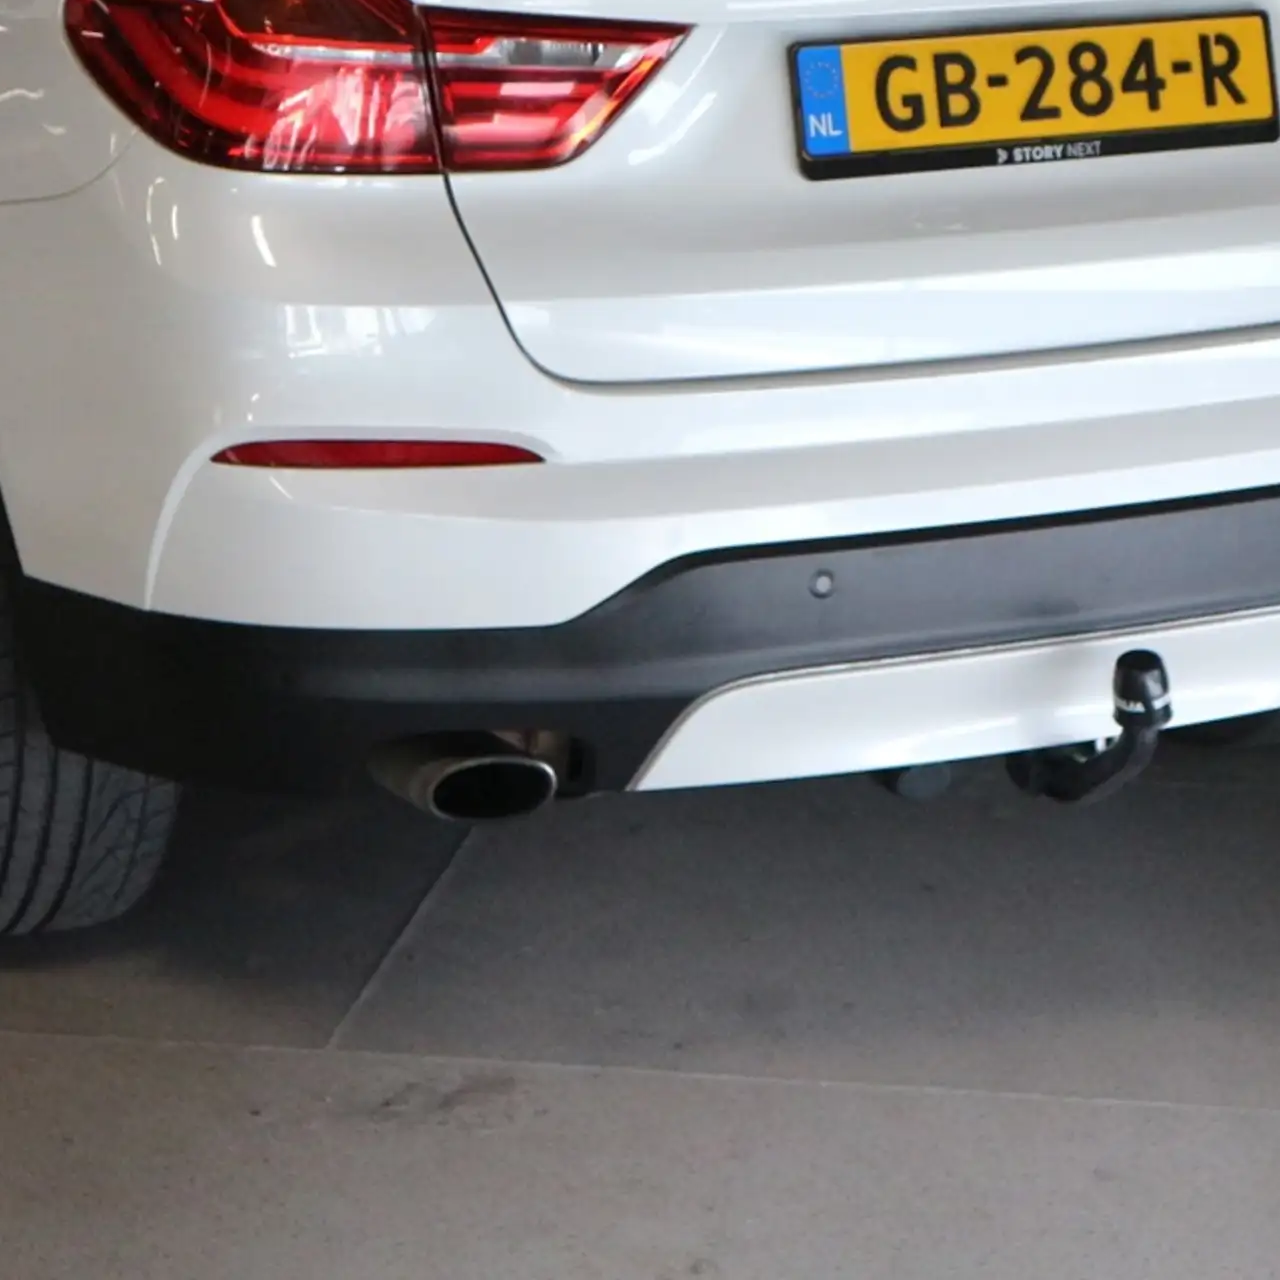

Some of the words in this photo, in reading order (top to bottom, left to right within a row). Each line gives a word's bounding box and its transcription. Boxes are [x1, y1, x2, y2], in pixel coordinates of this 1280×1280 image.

[809, 113, 843, 138] NL
[874, 32, 1247, 133] GB-284-R
[1012, 143, 1064, 162] STORY
[1065, 140, 1102, 158] NEXT
